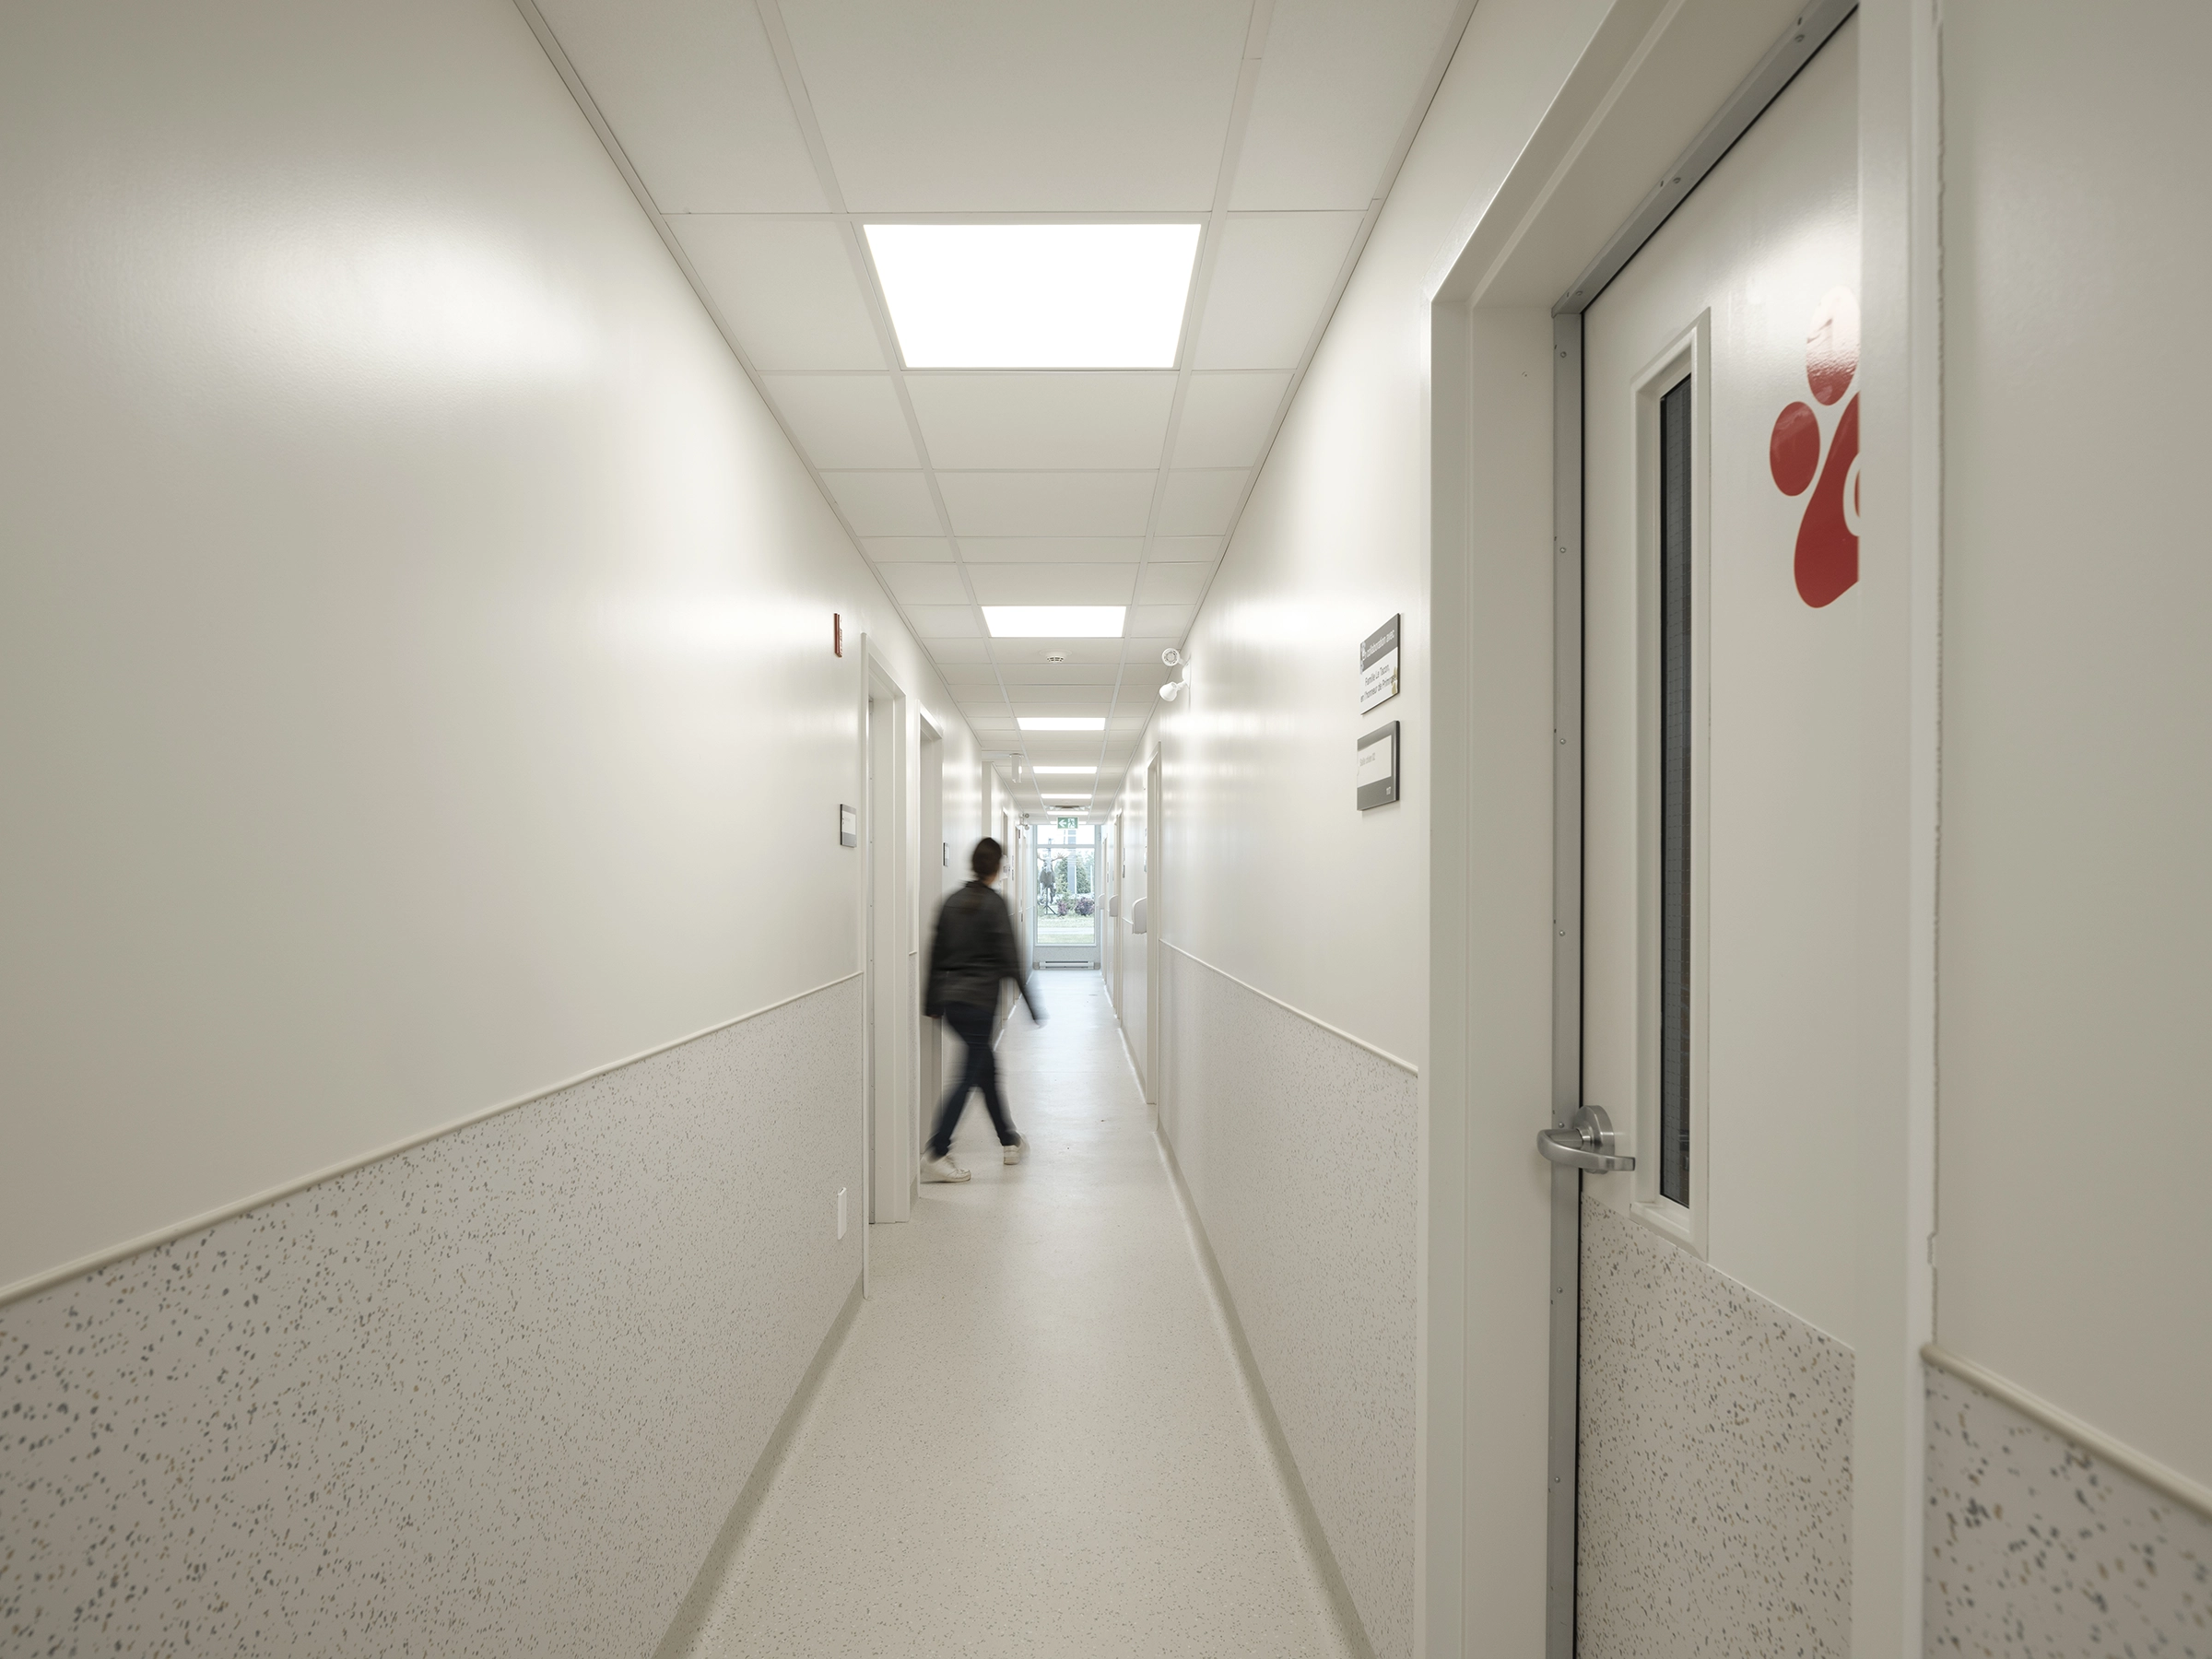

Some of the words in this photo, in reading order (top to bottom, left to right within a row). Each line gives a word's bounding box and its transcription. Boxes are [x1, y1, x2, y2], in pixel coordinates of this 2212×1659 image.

[1367, 636, 1386, 657] collaboration
[1386, 629, 1394, 642] avec
[1365, 672, 1376, 687] Famille
